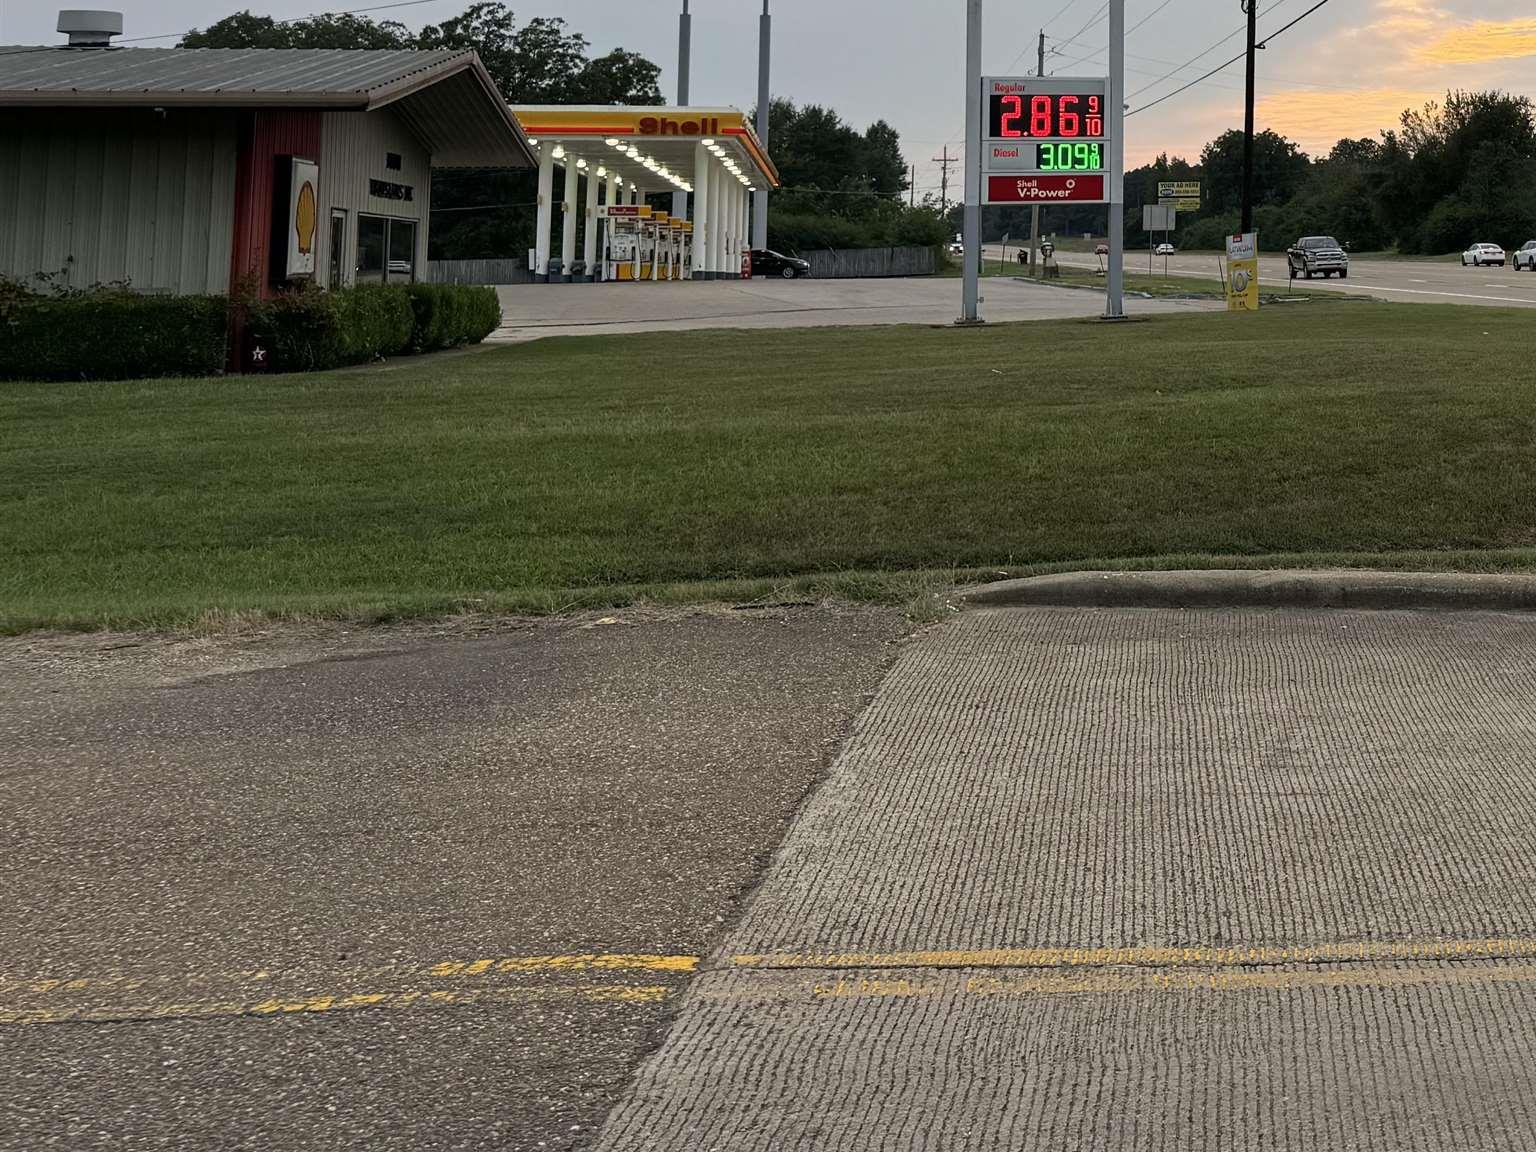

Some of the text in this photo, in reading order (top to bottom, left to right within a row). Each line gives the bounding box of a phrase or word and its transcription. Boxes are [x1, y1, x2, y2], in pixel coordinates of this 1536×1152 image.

[994, 83, 1025, 93] Regular
[1001, 95, 1079, 136] 2.86
[638, 117, 718, 135] Shell
[993, 148, 1019, 158] Diesel
[1040, 143, 1088, 170] 3.09
[1016, 179, 1037, 187] Shell
[1017, 188, 1071, 198] V-Power
